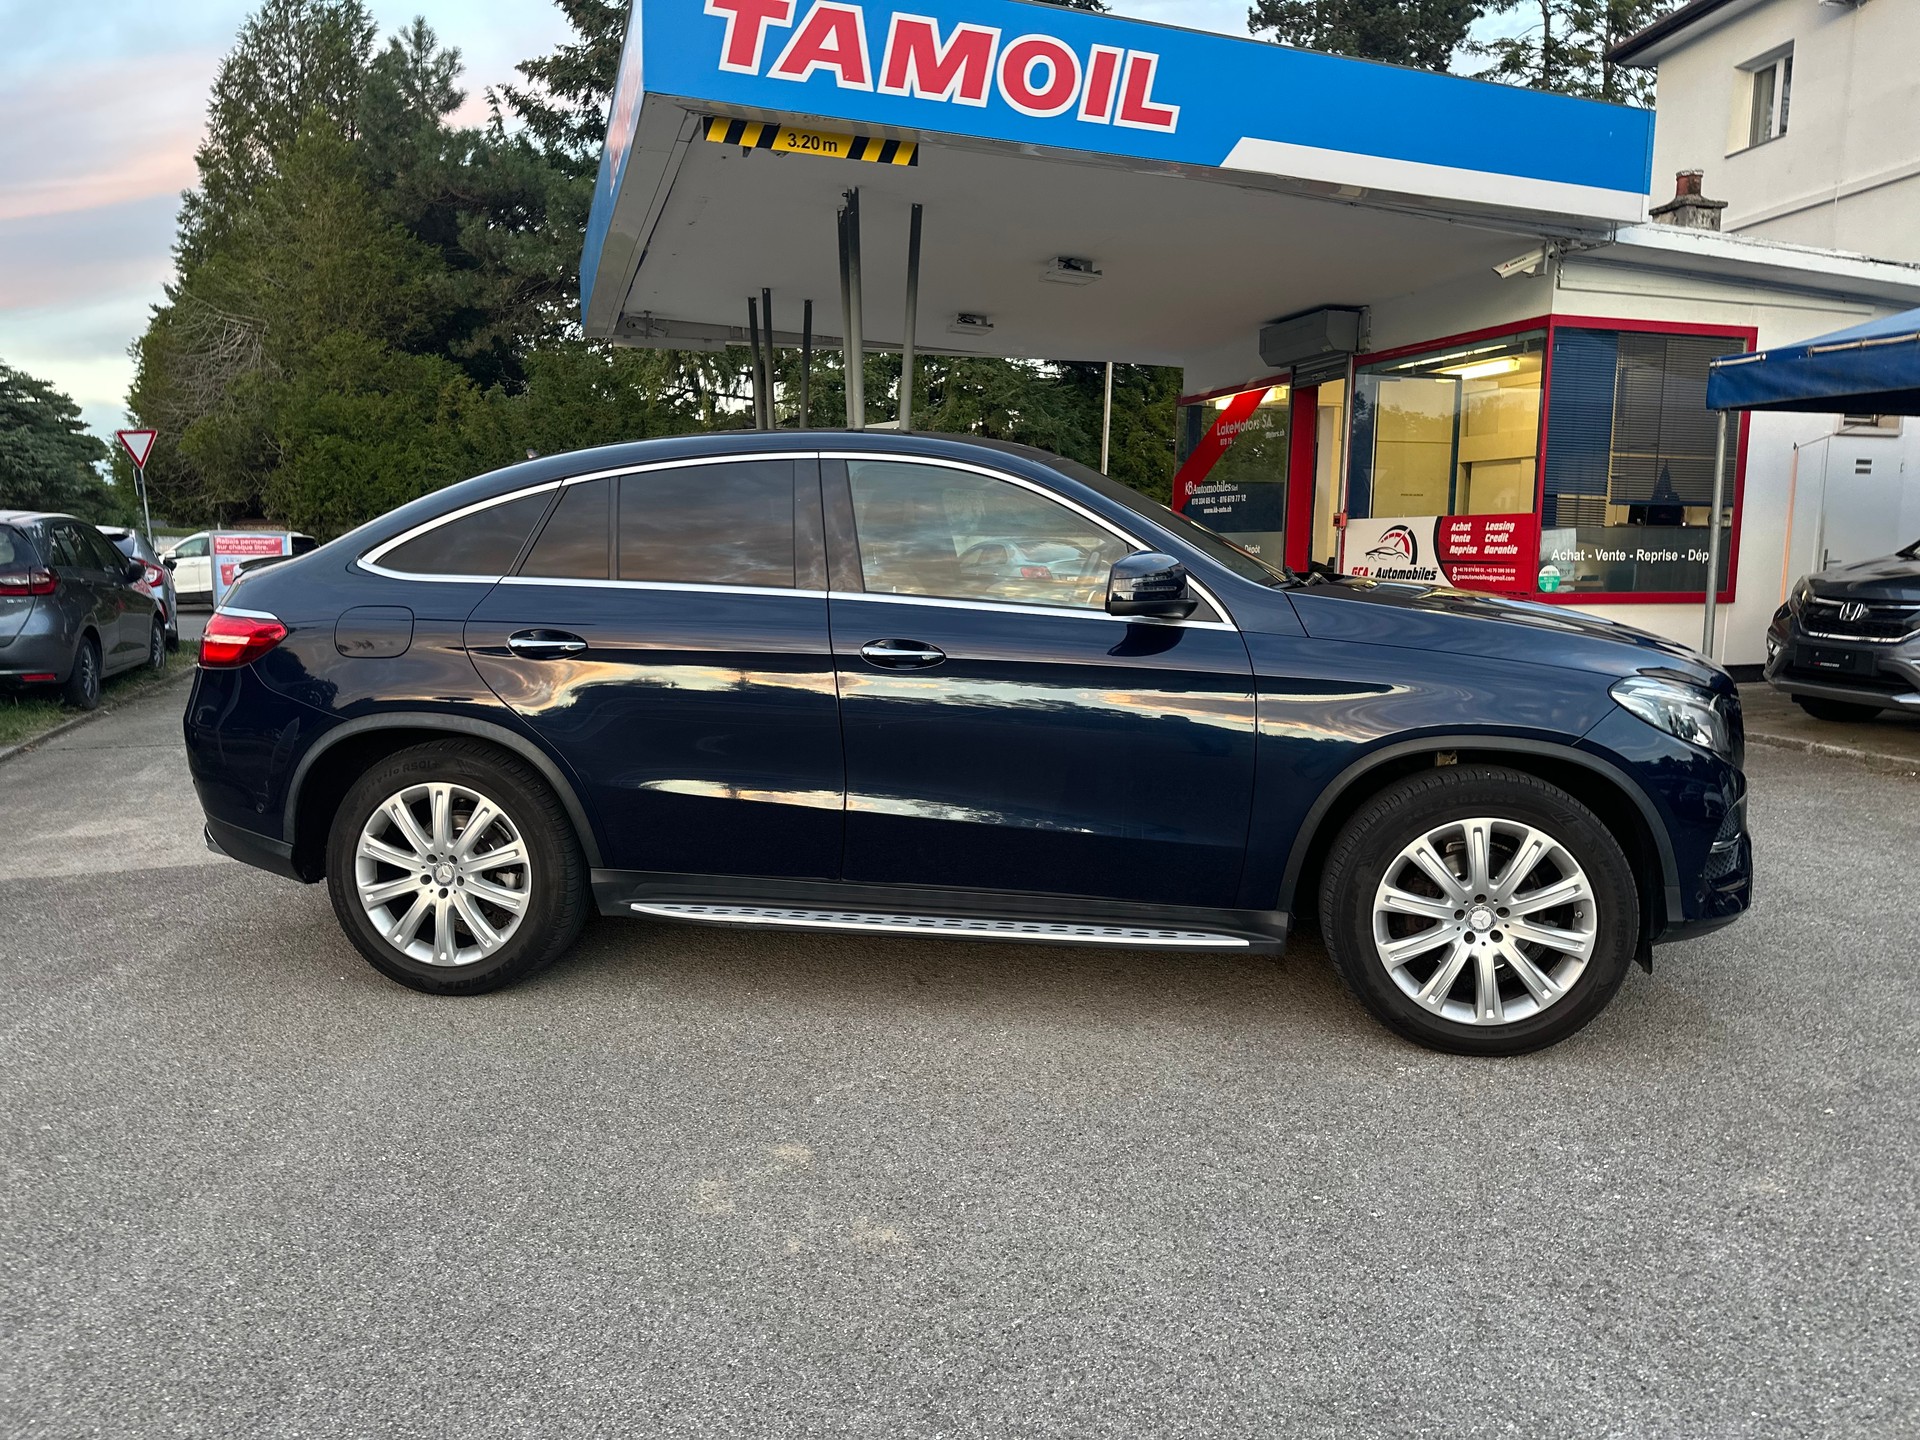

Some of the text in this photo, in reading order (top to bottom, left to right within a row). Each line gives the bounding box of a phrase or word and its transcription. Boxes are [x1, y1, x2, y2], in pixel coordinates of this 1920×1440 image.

[704, 0, 1180, 134] TAMOIL
[787, 132, 838, 153] 3.20 m
[1450, 520, 1515, 533] Achat Leasing
[216, 537, 275, 546] Rabais permanent
[1450, 532, 1509, 543] Vente Credit
[1449, 544, 1518, 556] Reprise Garantie
[1551, 548, 1585, 562] Achat
[1595, 548, 1626, 562] Vente
[1636, 548, 1679, 564] Reprise
[1688, 548, 1709, 564] Dép
[1375, 566, 1437, 581] Automobiles
